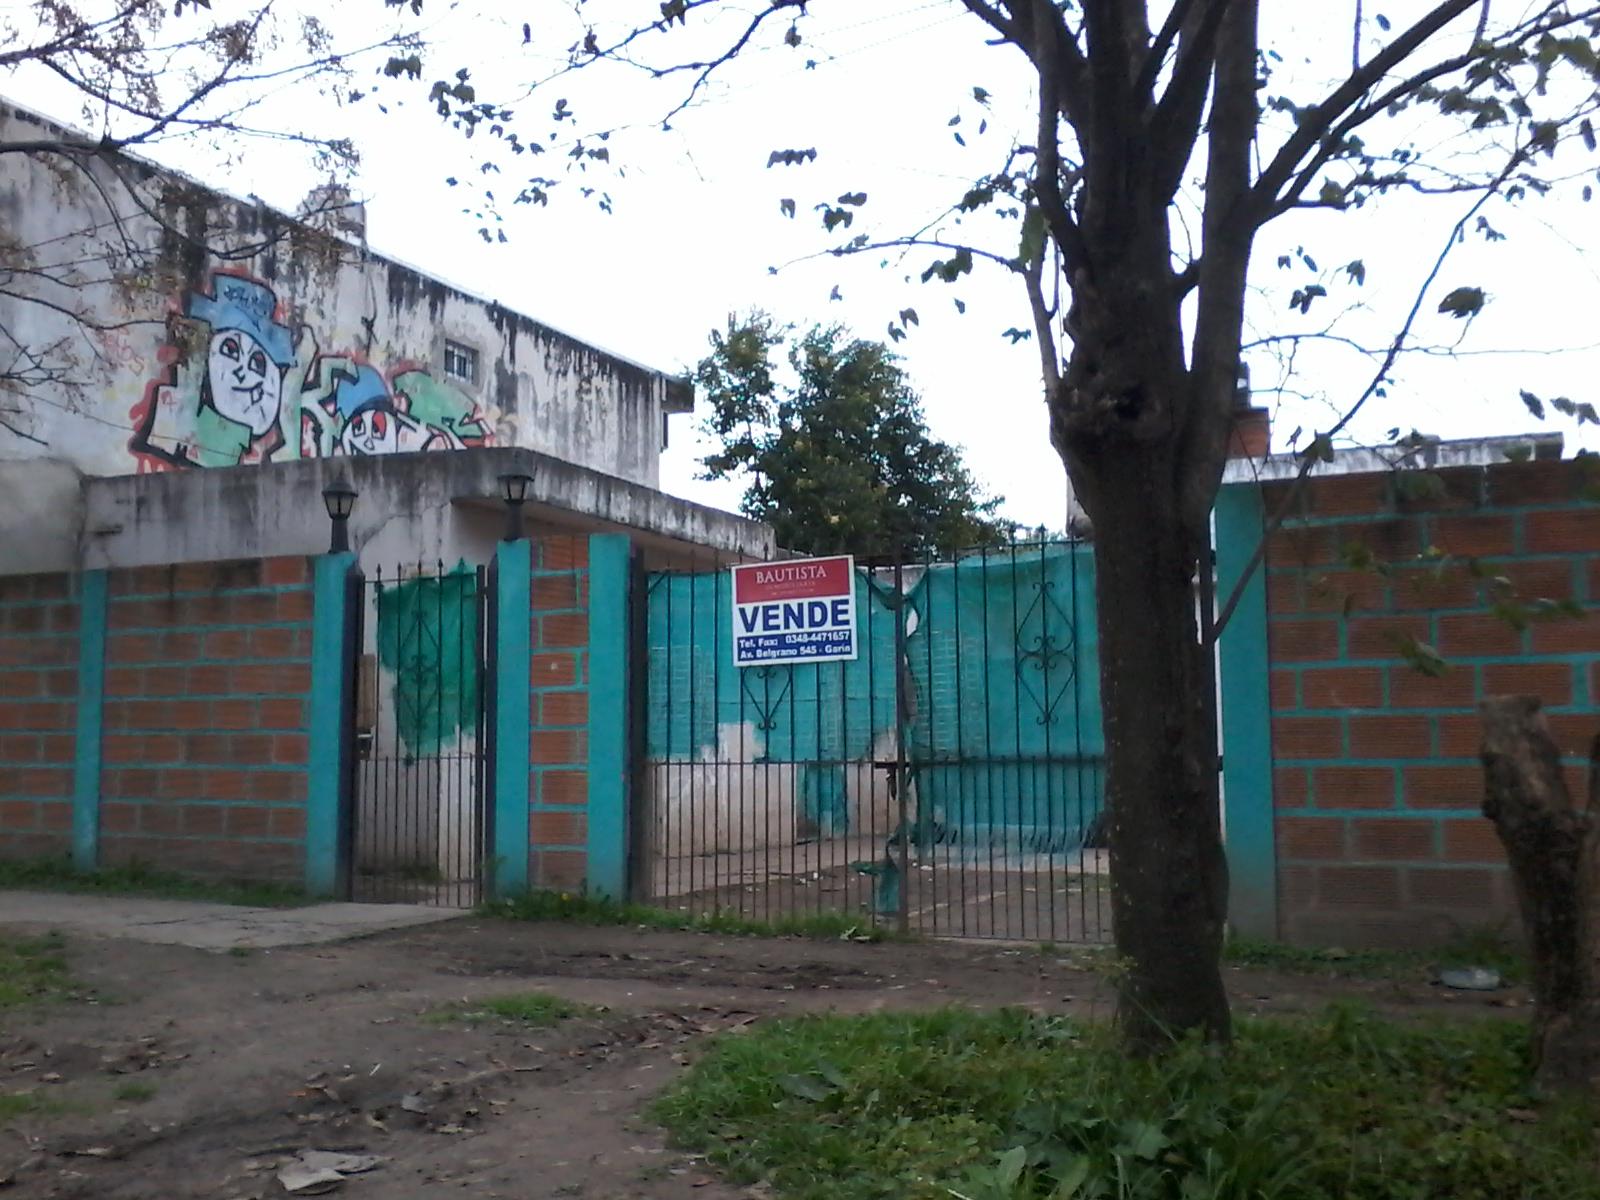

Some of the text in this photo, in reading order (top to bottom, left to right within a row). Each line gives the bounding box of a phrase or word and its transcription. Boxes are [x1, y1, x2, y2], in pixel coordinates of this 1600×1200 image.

[756, 565, 827, 584] BAUTISTA
[738, 599, 850, 633] VENDE
[739, 639, 756, 649] Tel.
[740, 650, 754, 660] Av.
[756, 648, 798, 659] Belgrano
